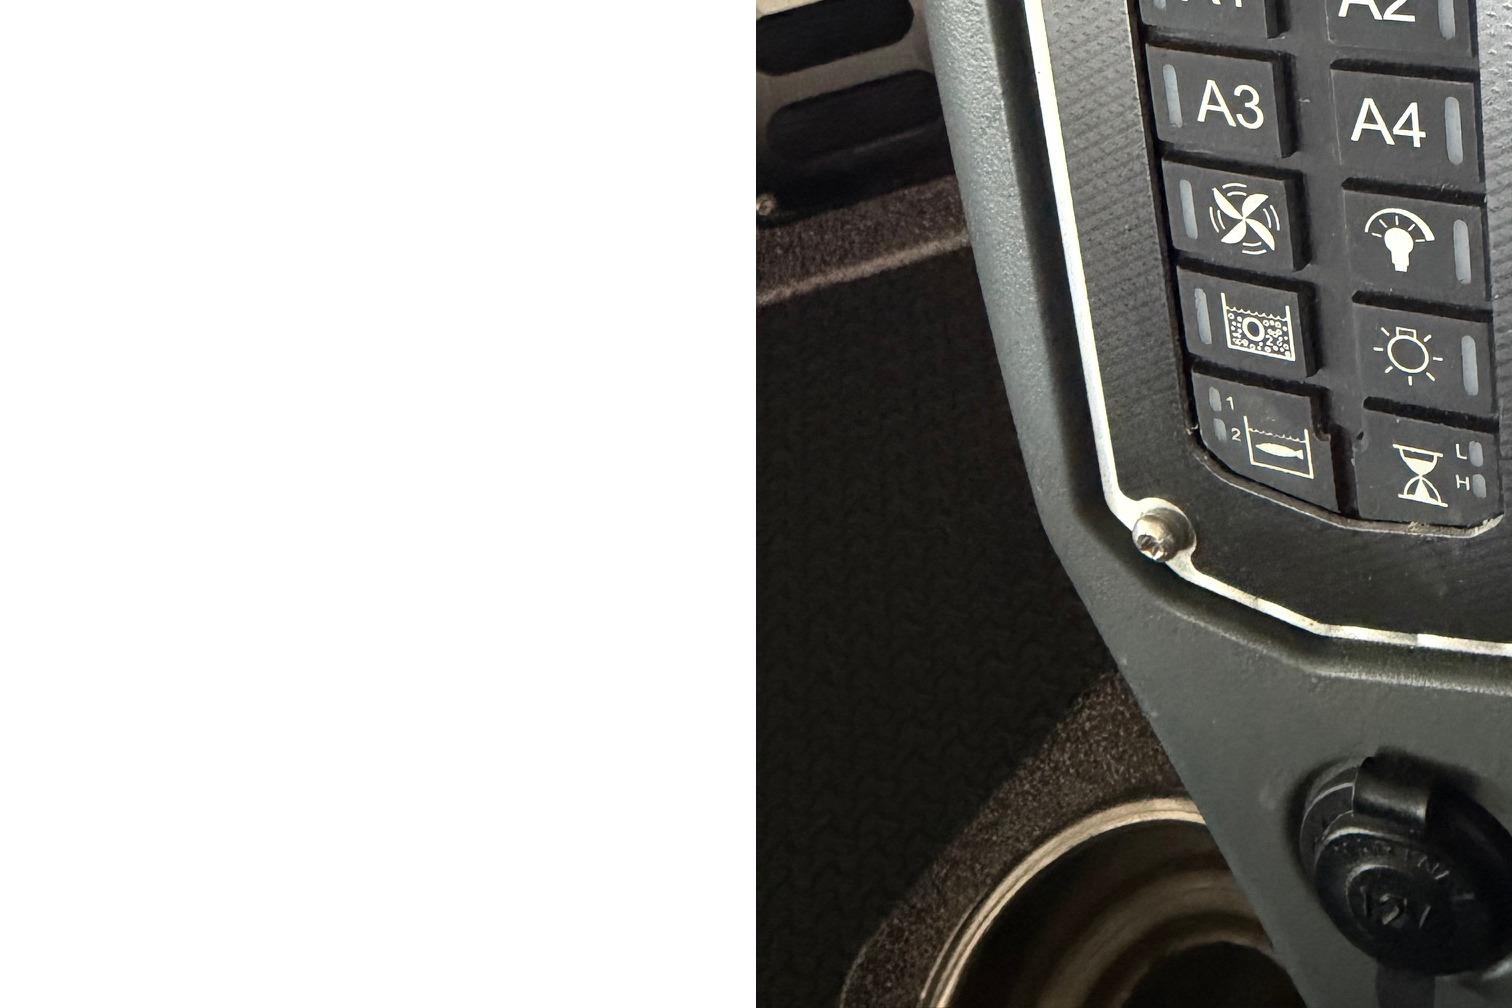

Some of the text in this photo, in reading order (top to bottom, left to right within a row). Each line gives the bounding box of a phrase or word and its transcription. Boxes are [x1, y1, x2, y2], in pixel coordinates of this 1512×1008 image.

[1197, 79, 1265, 130] A3
[1350, 97, 1426, 148] A4
[1225, 396, 1234, 410] 1
[1231, 427, 1242, 442] 2
[1456, 443, 1467, 460] L
[1456, 475, 1470, 491] H
